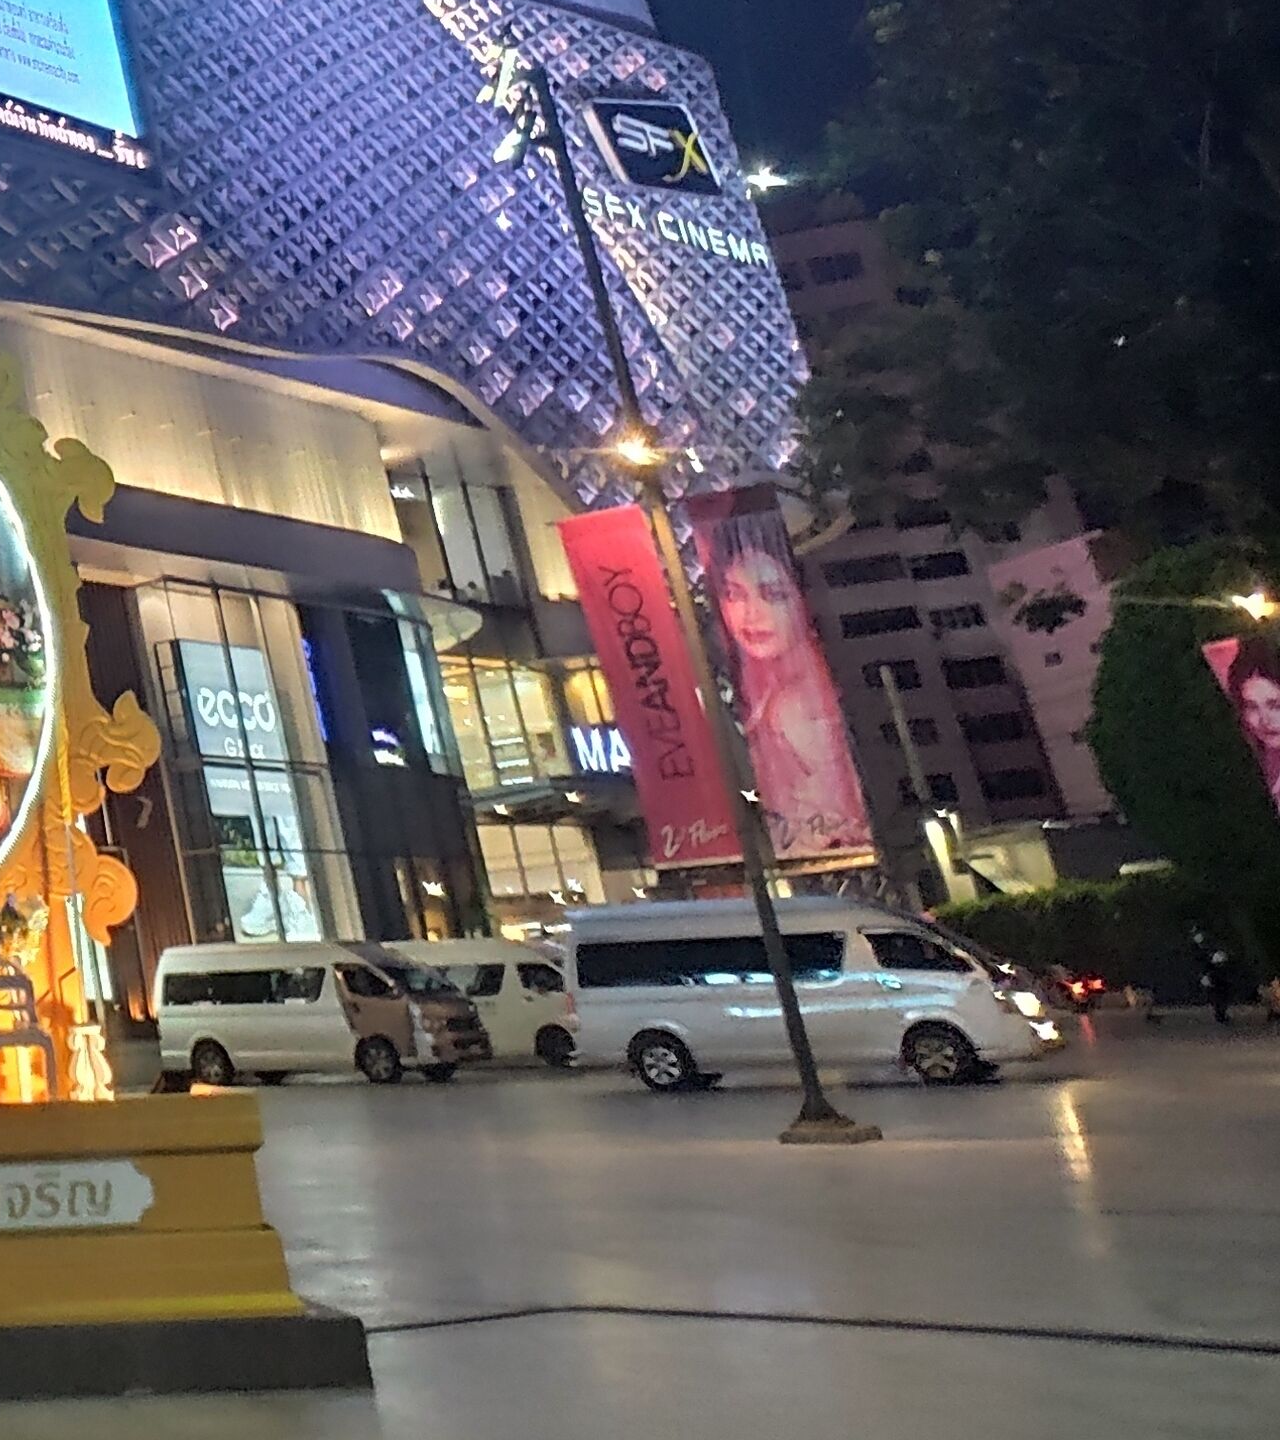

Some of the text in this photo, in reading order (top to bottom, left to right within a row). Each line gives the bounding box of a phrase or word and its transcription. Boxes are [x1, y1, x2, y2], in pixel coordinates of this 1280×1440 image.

[612, 113, 708, 183] SFX
[583, 187, 770, 266] SFX CINEMA
[597, 563, 697, 782] EVEANDBOY
[197, 687, 276, 733] ecco
